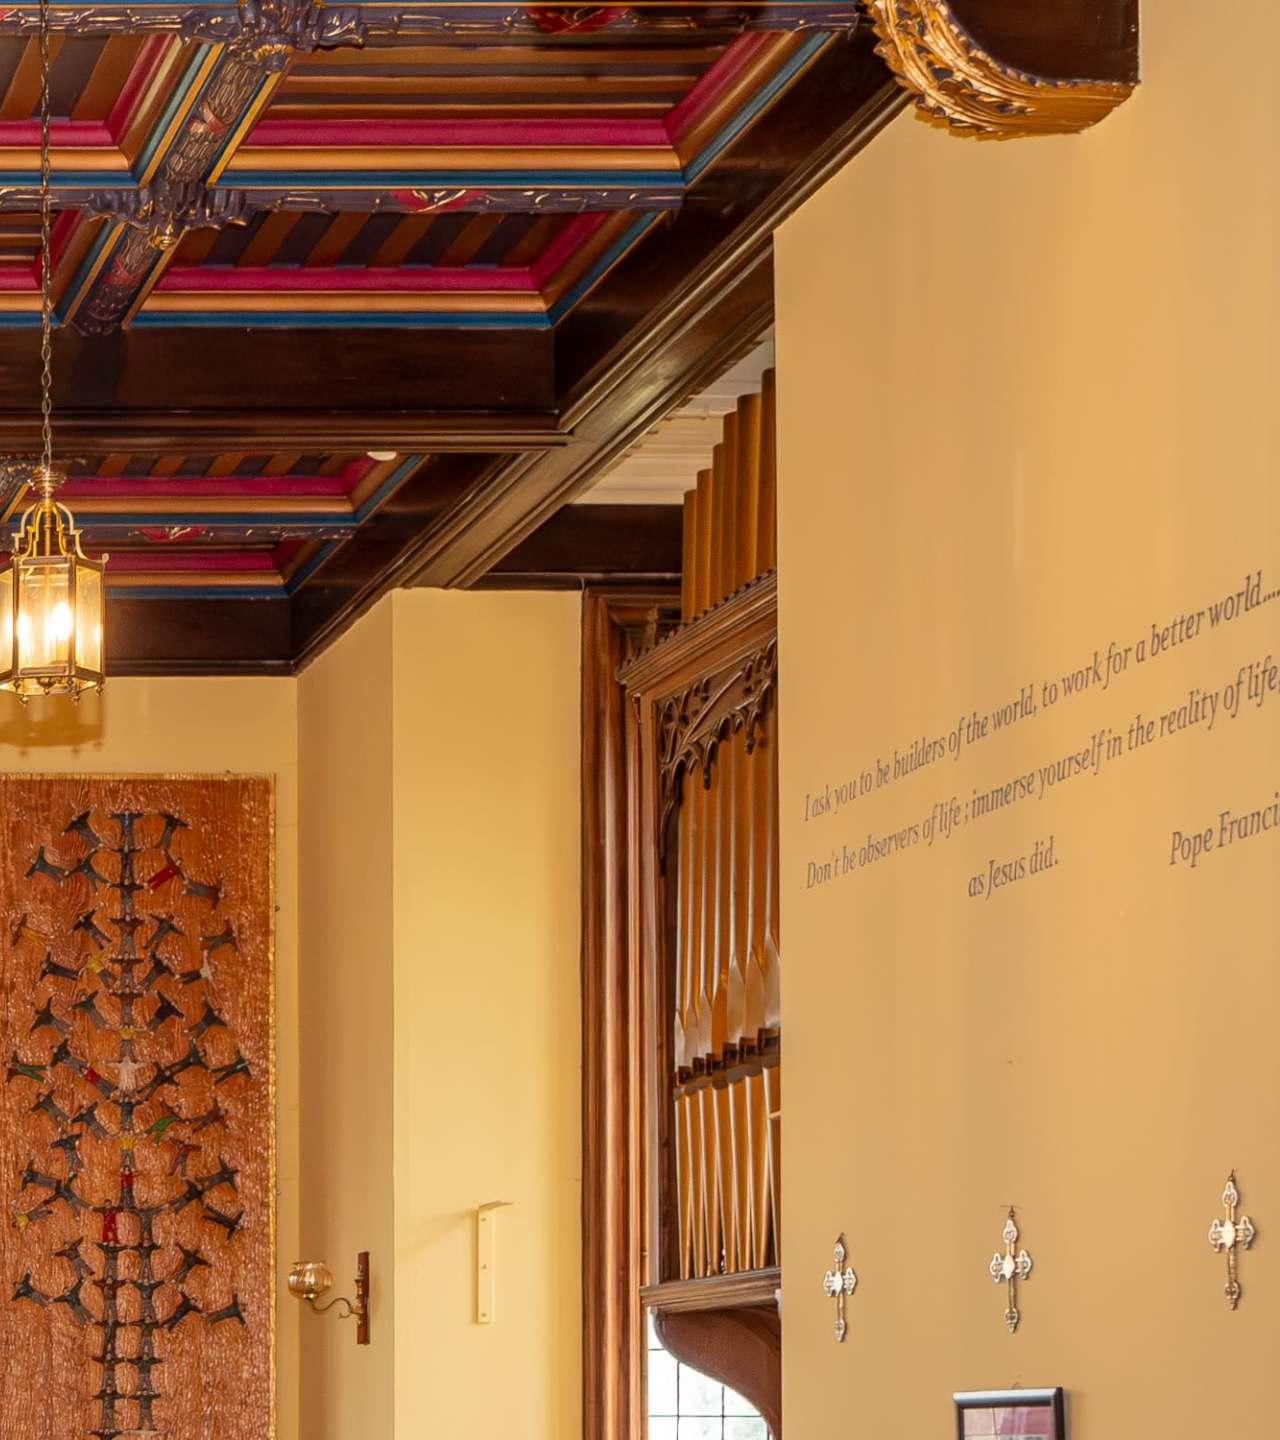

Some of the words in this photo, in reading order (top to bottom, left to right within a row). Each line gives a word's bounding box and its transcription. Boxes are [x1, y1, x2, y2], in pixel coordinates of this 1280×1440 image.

[804, 793, 811, 822] I
[811, 784, 832, 818] ask
[833, 778, 857, 815] you
[859, 770, 873, 797] to
[876, 758, 891, 789] be
[893, 736, 947, 781] builders
[948, 716, 966, 761] of
[966, 711, 989, 745] the
[991, 683, 1037, 732] world,
[1042, 681, 1058, 708] to
[1061, 651, 1102, 698] work
[1102, 641, 1133, 691] for
[1135, 640, 1146, 664] a
[1151, 610, 1205, 657] better
[806, 850, 841, 890] Don't
[842, 845, 856, 875] be
[858, 824, 920, 868] observers
[922, 804, 938, 847] of
[939, 796, 961, 839] life
[971, 772, 1035, 819] immerse
[1039, 728, 1105, 801] yourself
[1106, 728, 1123, 761] in
[1128, 713, 1155, 751] the
[1159, 688, 1220, 731] reality
[1223, 667, 1246, 719] of
[968, 873, 985, 897] as
[985, 856, 1027, 901] Jesus
[1029, 835, 1059, 875] did.
[1169, 826, 1214, 868] Pope
[1216, 791, 1280, 848] Franci
